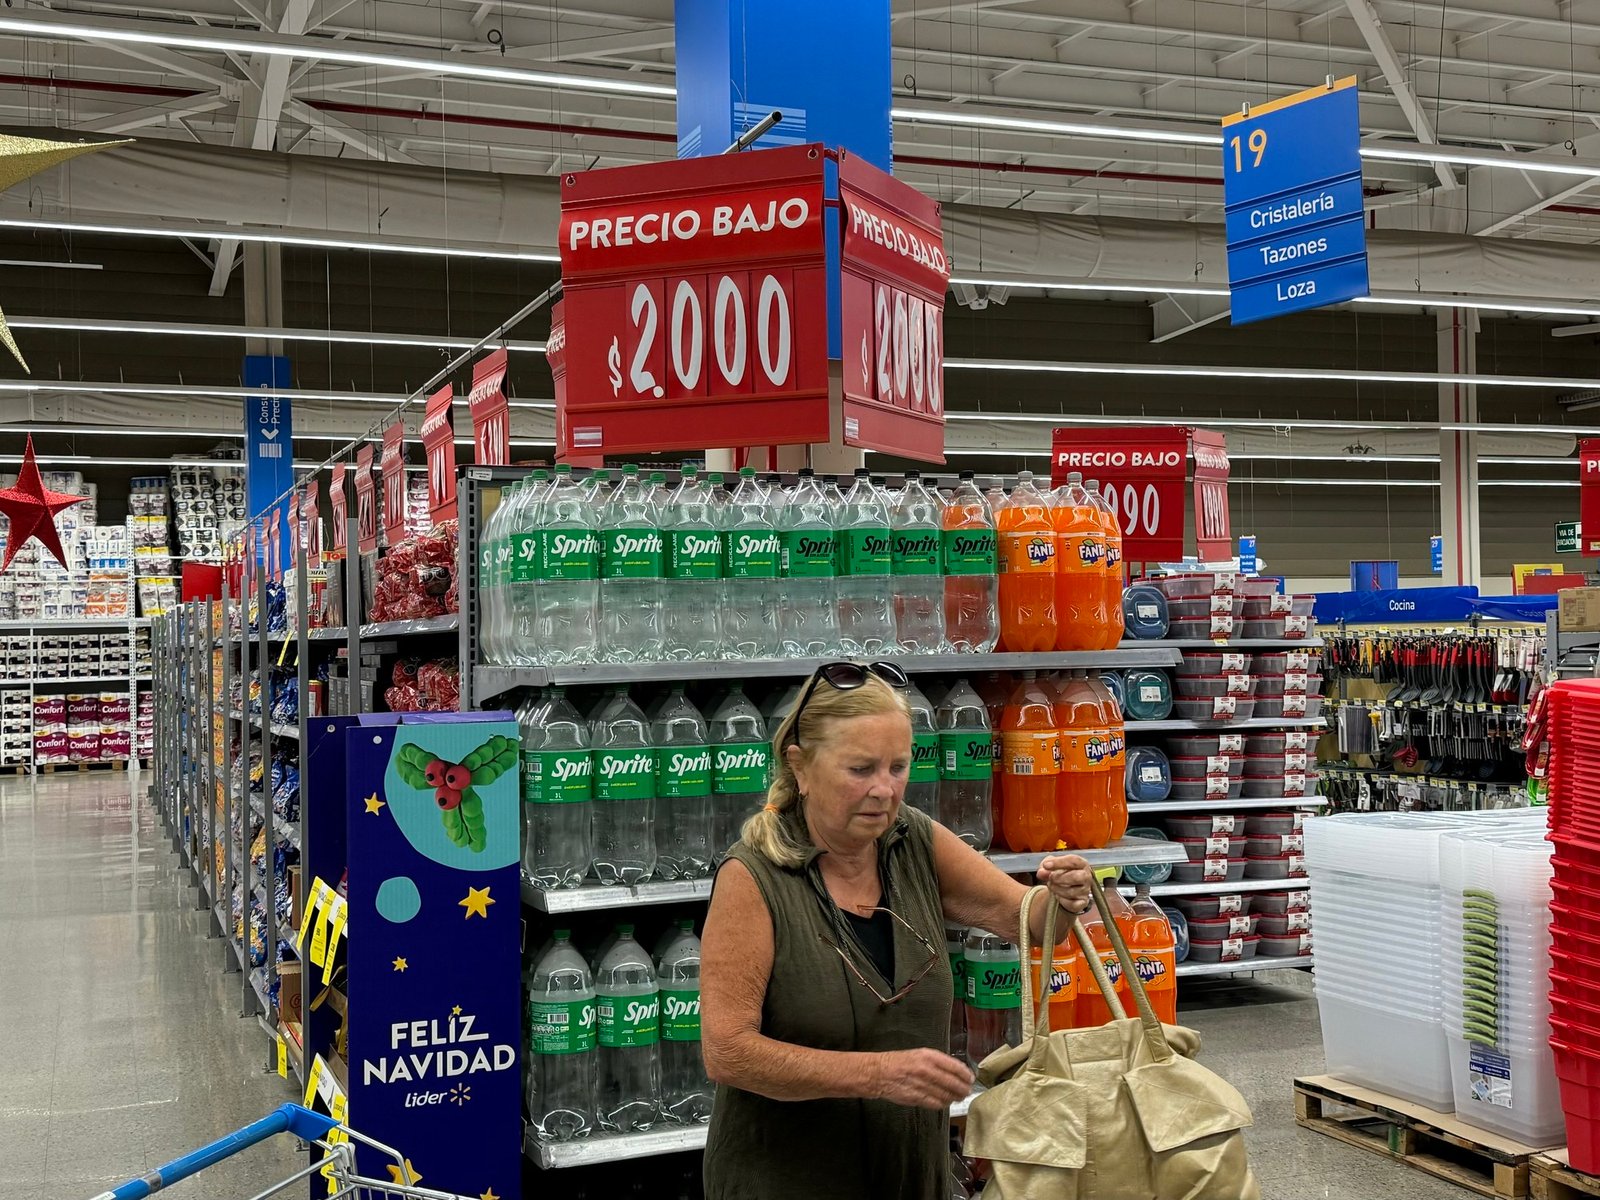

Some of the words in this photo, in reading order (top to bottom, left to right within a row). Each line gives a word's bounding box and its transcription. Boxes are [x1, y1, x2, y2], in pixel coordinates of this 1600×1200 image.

[1230, 129, 1267, 172] 19
[1250, 193, 1334, 228] Cristalería
[570, 209, 701, 250] PRECIO
[713, 197, 808, 236] BAJO
[850, 203, 908, 256] PRECIO
[908, 232, 946, 274] BAJO
[1260, 238, 1327, 265] Tazones
[1277, 280, 1316, 302] Loza
[1059, 452, 1126, 467] PRECIO
[1132, 451, 1180, 466] BAJO
[613, 533, 663, 558] Sprite
[893, 535, 940, 556] Sprite
[952, 535, 996, 556] Sprite
[1389, 599, 1415, 611] Cocina
[34, 705, 65, 715] Confort
[68, 704, 97, 713] Confort
[36, 738, 66, 749] Confort
[70, 740, 99, 749] Confort
[600, 753, 653, 779] Sprite
[715, 748, 766, 773] Sprite
[982, 968, 1022, 990] Sprit
[364, 1044, 516, 1086] NAVIDAD
